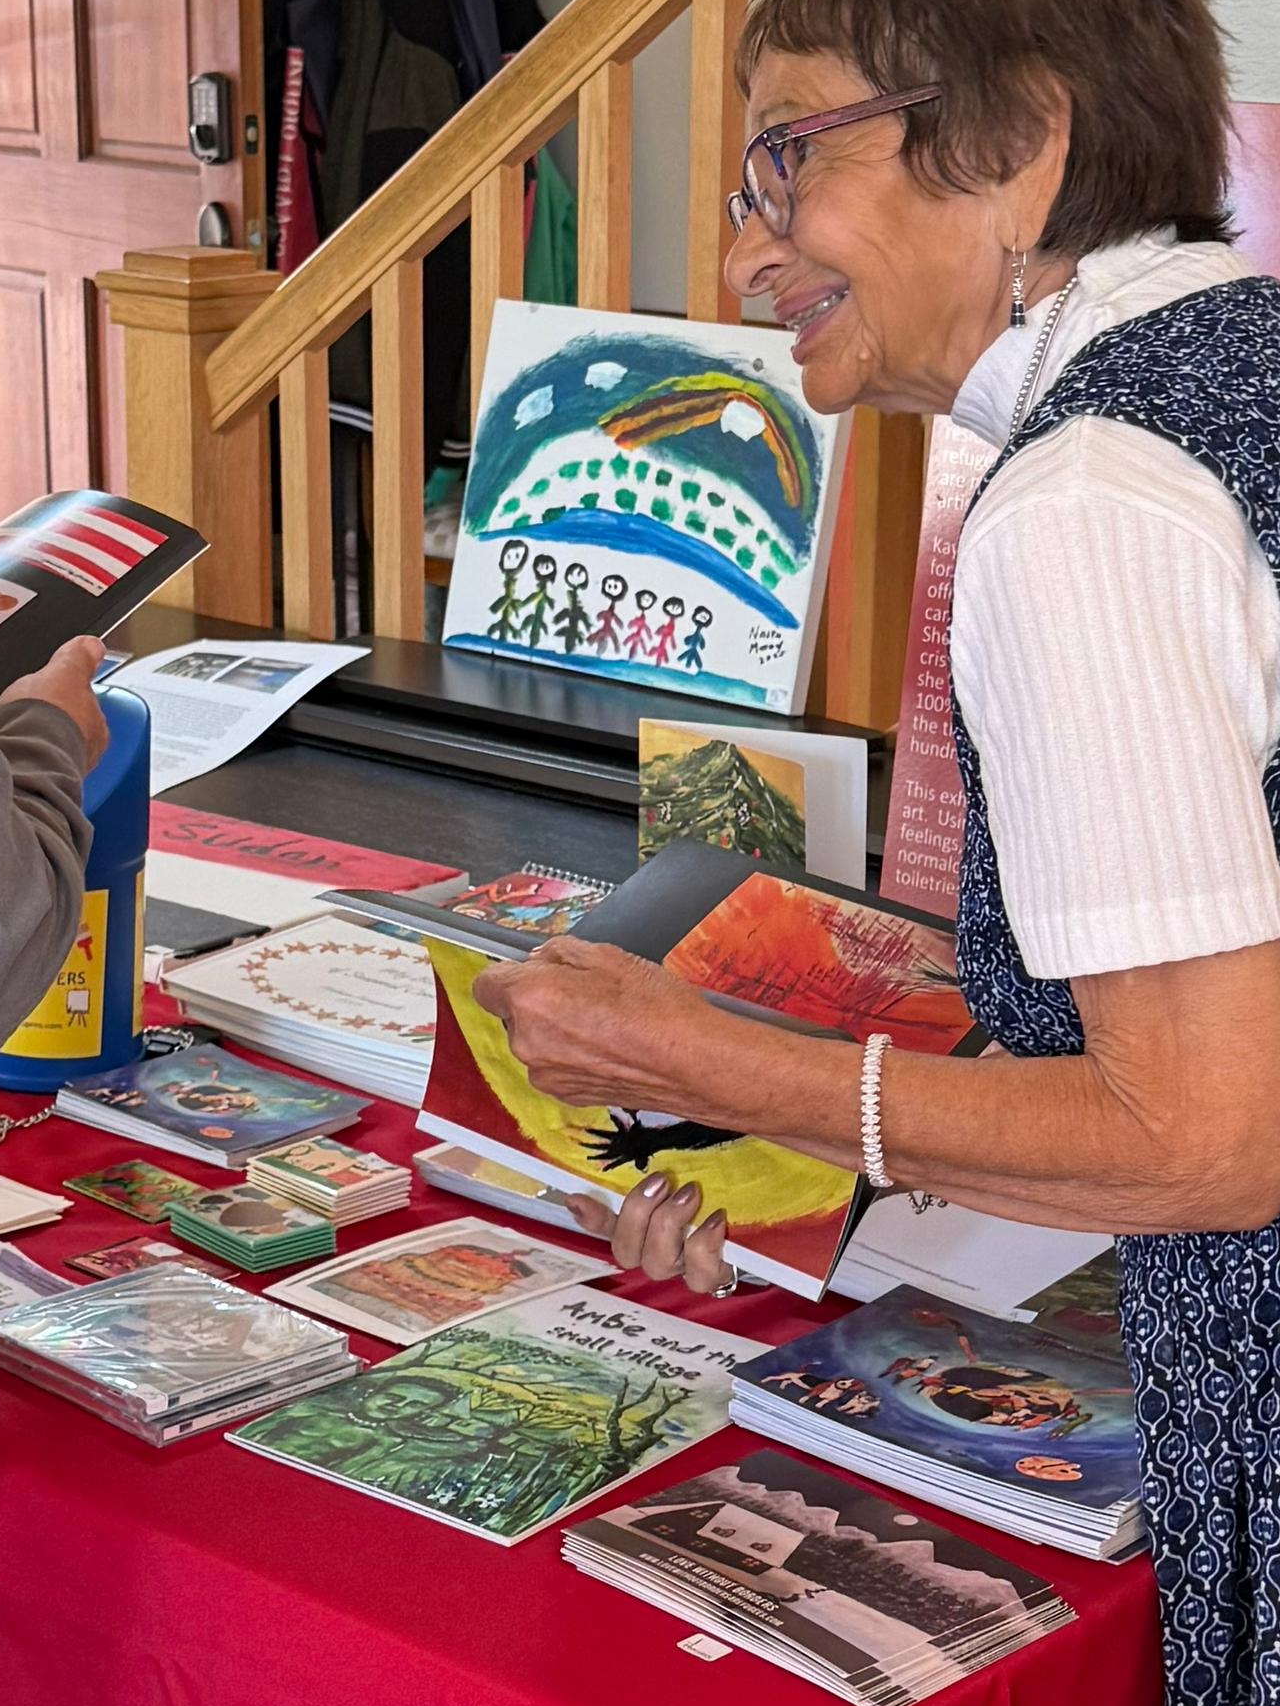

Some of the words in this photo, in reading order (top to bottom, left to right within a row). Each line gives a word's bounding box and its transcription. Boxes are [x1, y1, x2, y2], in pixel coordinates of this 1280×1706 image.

[940, 471, 966, 488] are
[919, 650, 947, 668] cris
[917, 670, 945, 690] she
[913, 714, 938, 734] the
[910, 735, 957, 759] hundr
[905, 779, 937, 801] This
[902, 804, 928, 823] art.
[900, 823, 963, 855] feelings,
[897, 849, 961, 873] normalc
[895, 868, 956, 895] toiletrie
[546, 1325, 616, 1353] small
[616, 1348, 702, 1381] village
[651, 1335, 707, 1354] and
[704, 1349, 737, 1369] th
[667, 1554, 697, 1570] LOVE
[692, 1565, 738, 1590] WITHOUT
[731, 1581, 780, 1612] BORDERS
